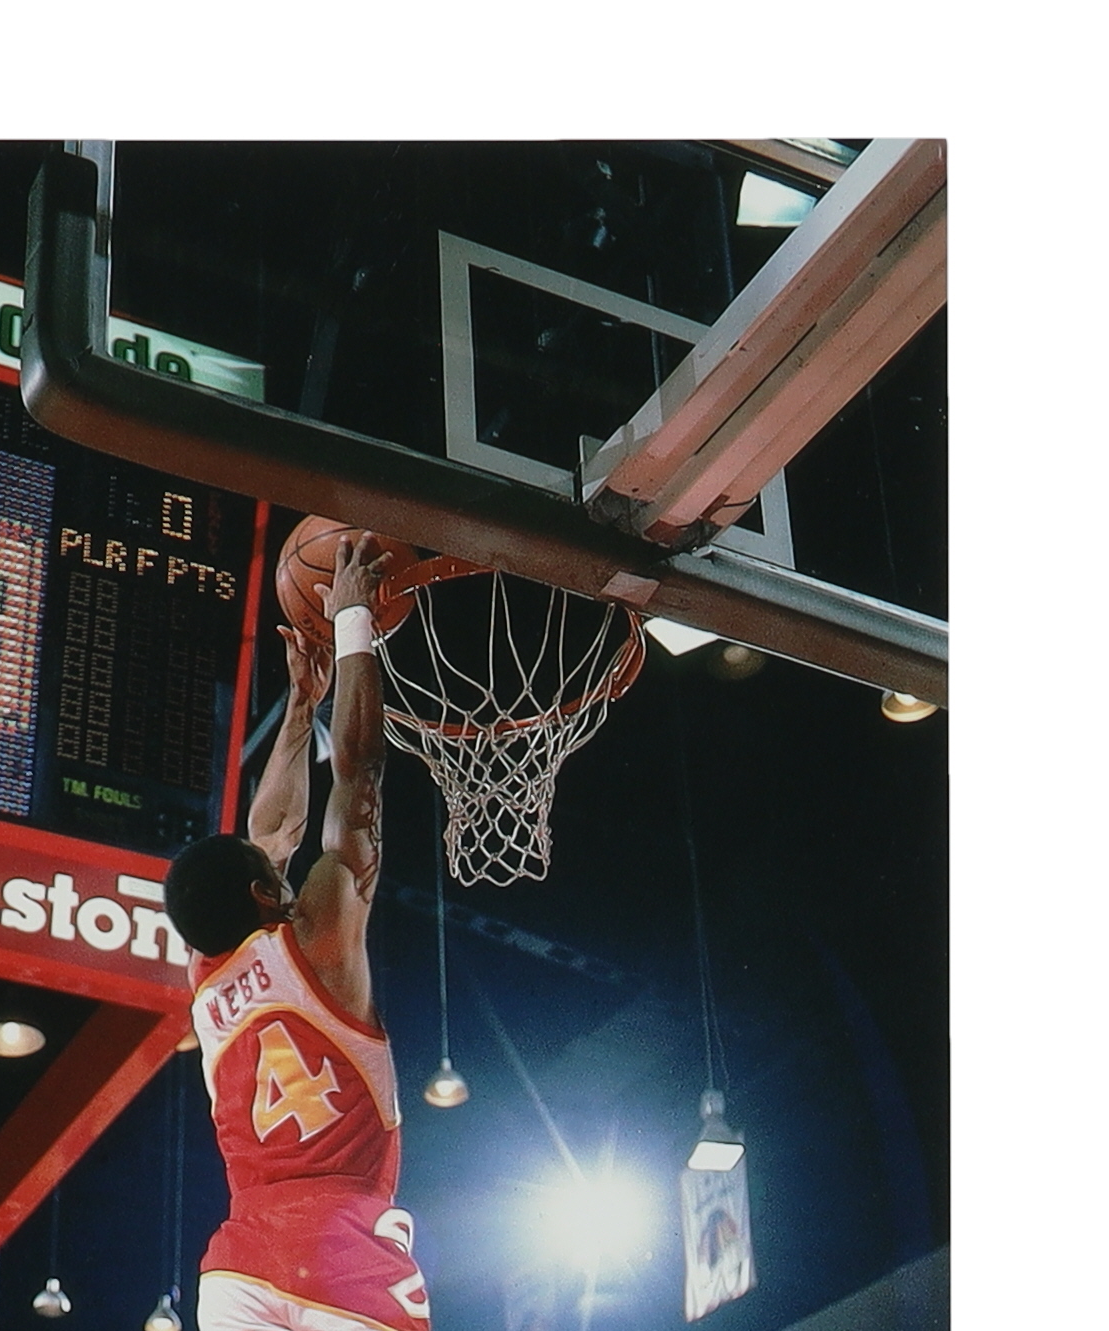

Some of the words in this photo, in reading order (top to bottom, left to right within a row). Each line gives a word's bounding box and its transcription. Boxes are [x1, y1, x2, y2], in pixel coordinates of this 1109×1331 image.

[161, 490, 193, 541] 0
[60, 527, 128, 573] PLR
[137, 547, 160, 576] F
[167, 555, 237, 601] PTS
[206, 959, 272, 1030] WEBB
[252, 1020, 345, 1143] 4
